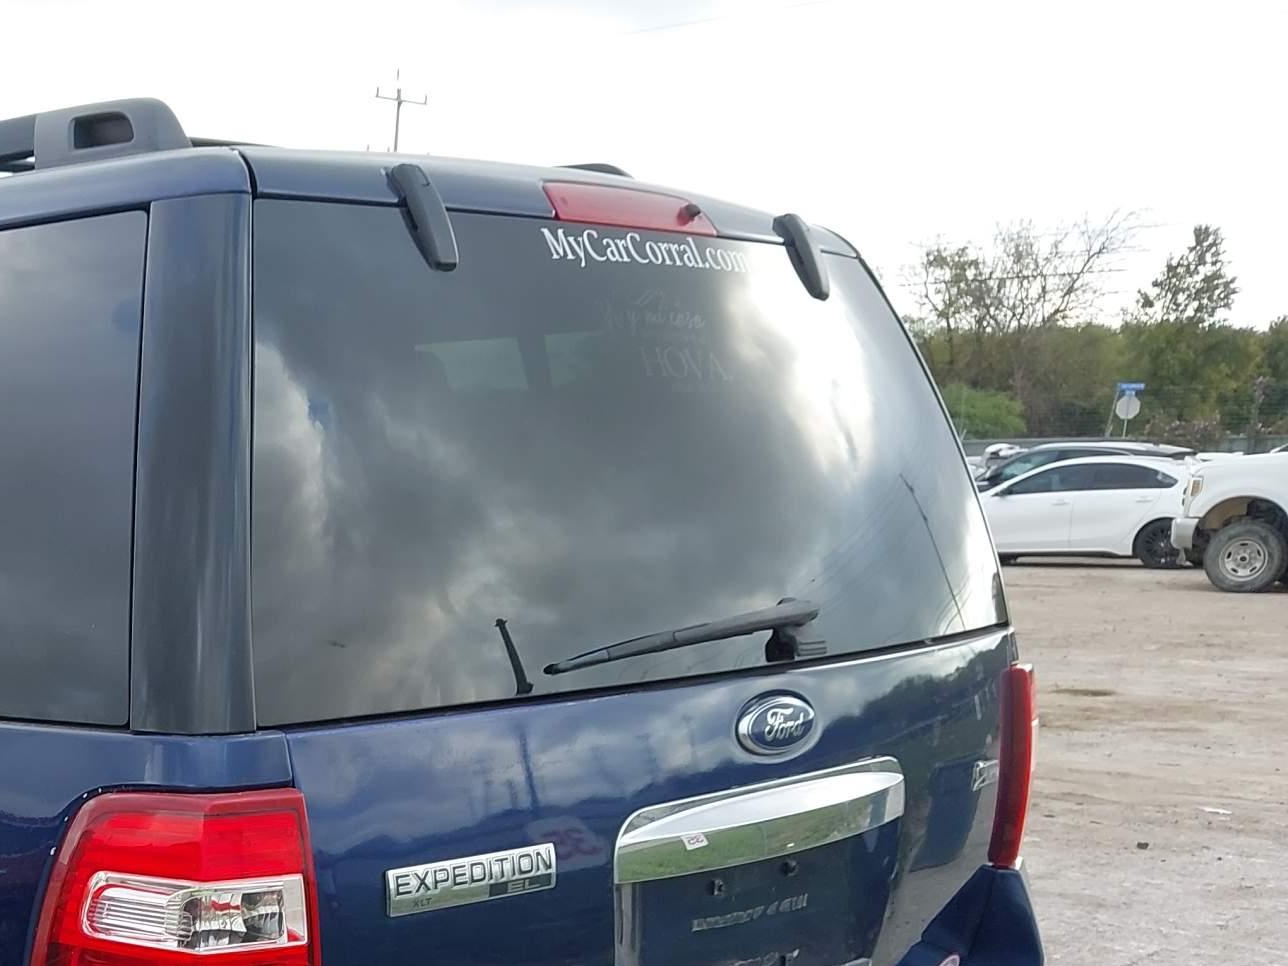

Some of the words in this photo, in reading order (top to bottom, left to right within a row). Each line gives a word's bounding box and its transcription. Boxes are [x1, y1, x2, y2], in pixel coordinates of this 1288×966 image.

[540, 228, 750, 274] MyCarCorral.com
[764, 707, 806, 741] Ford
[395, 849, 553, 897] EXPEDITION
[507, 878, 541, 894] EL
[412, 897, 433, 908] XLT
